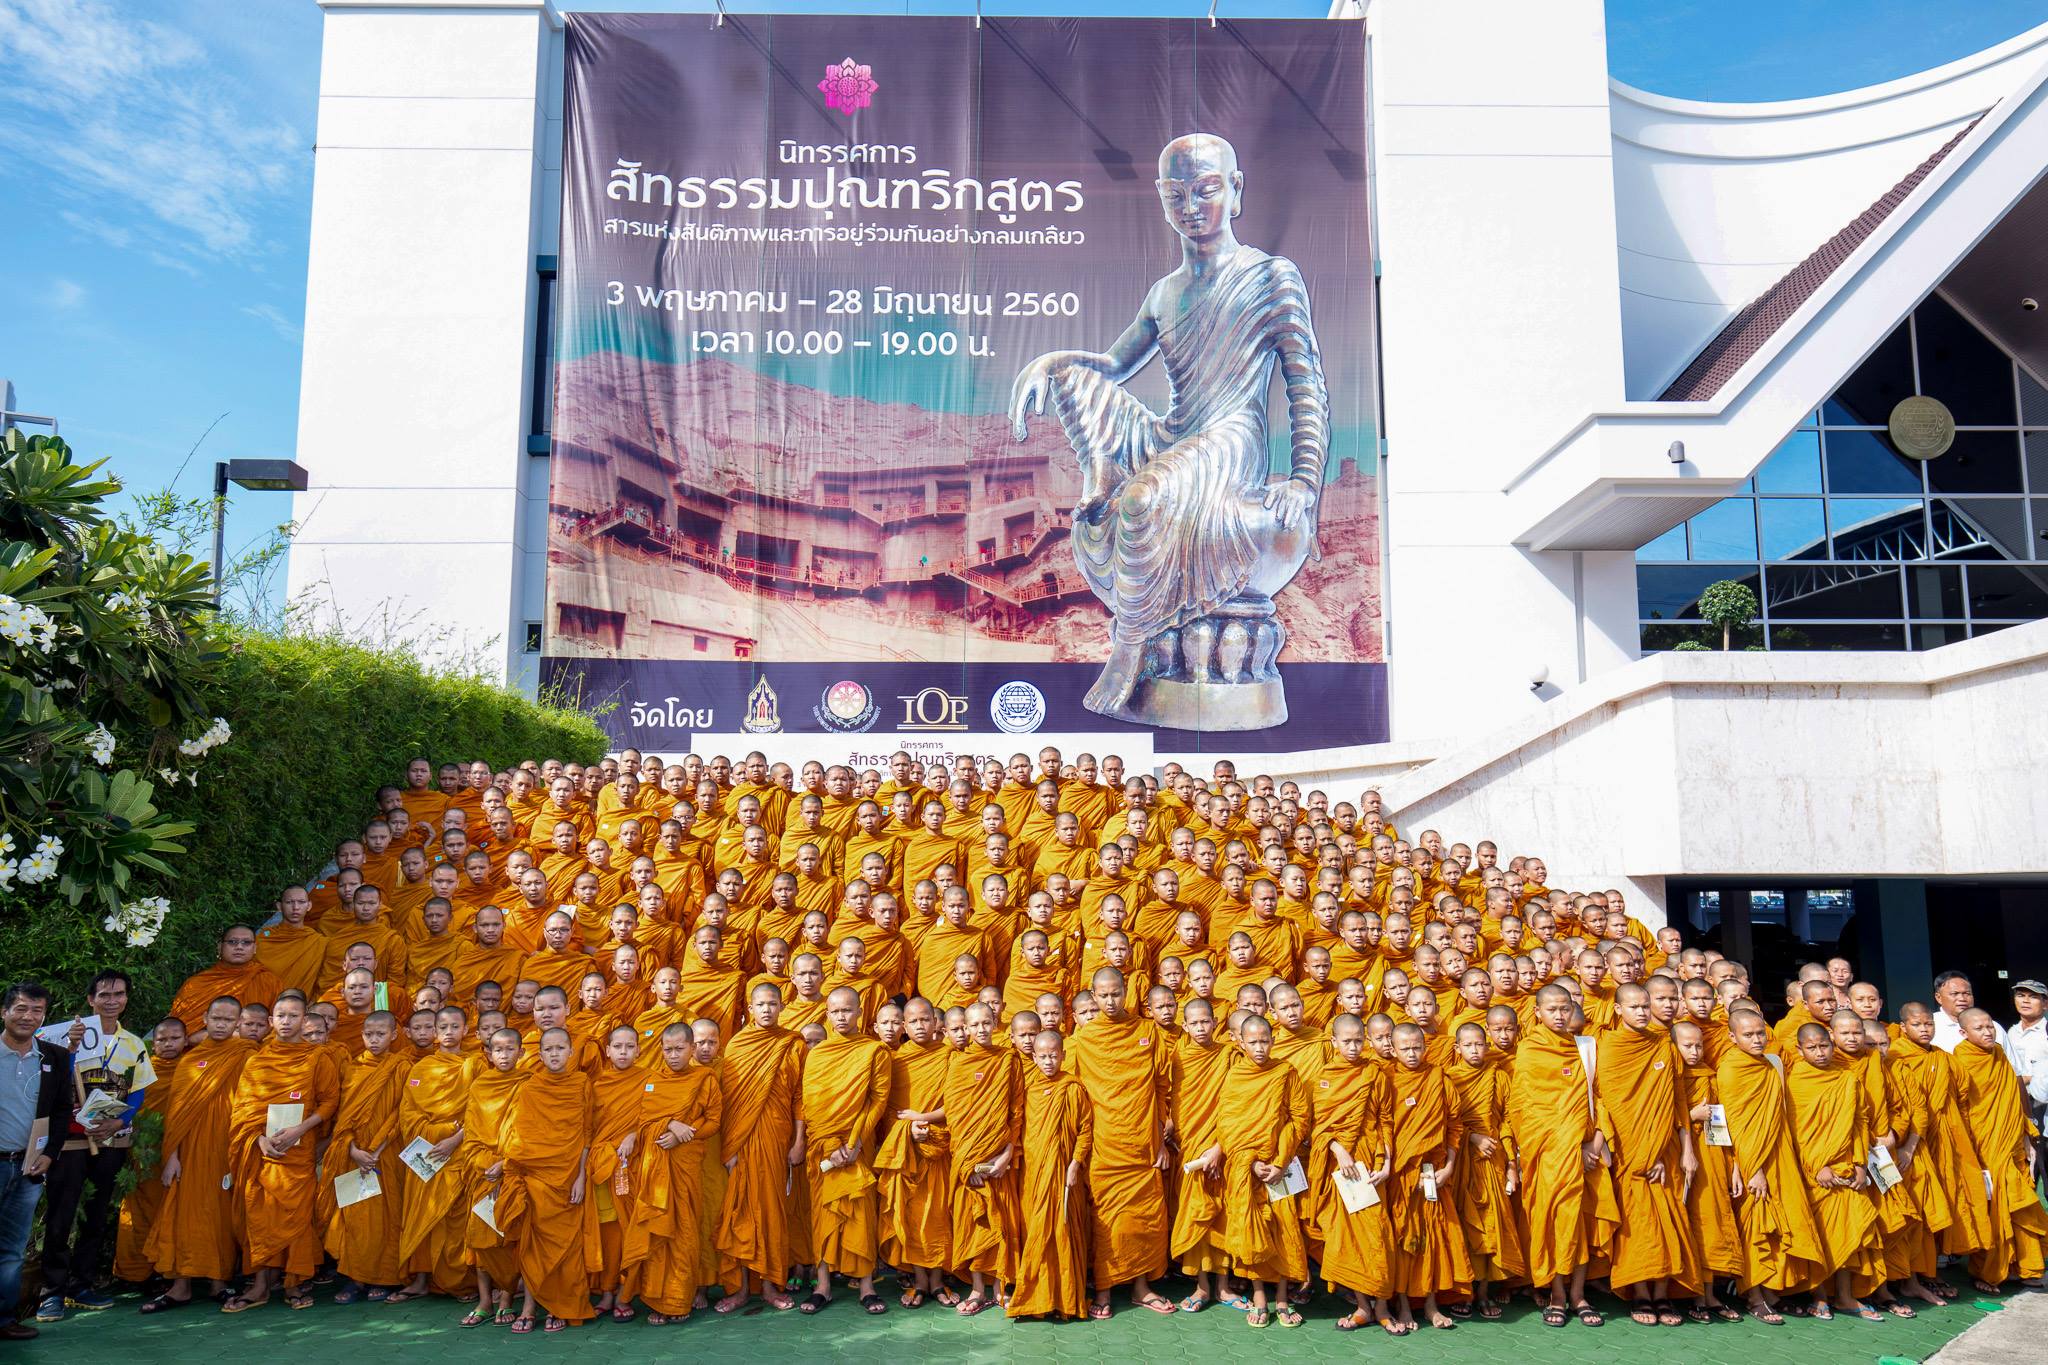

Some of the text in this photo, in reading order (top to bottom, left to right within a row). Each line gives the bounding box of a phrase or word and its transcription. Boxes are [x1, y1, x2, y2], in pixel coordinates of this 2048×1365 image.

[779, 139, 917, 164] นิทรรศการ
[605, 158, 1085, 224] สัทธรรมปุณฑริกสูตร
[603, 217, 1085, 246] สารแห่งสันติภาพและการอยู่ร่วมกันอย่างกลมเกลียว
[606, 280, 625, 306] 3
[634, 285, 787, 323] พฤษภาคม
[825, 289, 863, 314] 28
[872, 286, 993, 322] มิถุนายน
[1002, 292, 1080, 316] 2560
[692, 330, 755, 353] เวลา
[765, 330, 843, 355] 10.00
[881, 332, 958, 356] 19.00
[967, 335, 996, 357] น.
[630, 696, 714, 728] จัดโดย
[902, 689, 969, 724] IOP
[900, 740, 944, 749] นิทรรศการ
